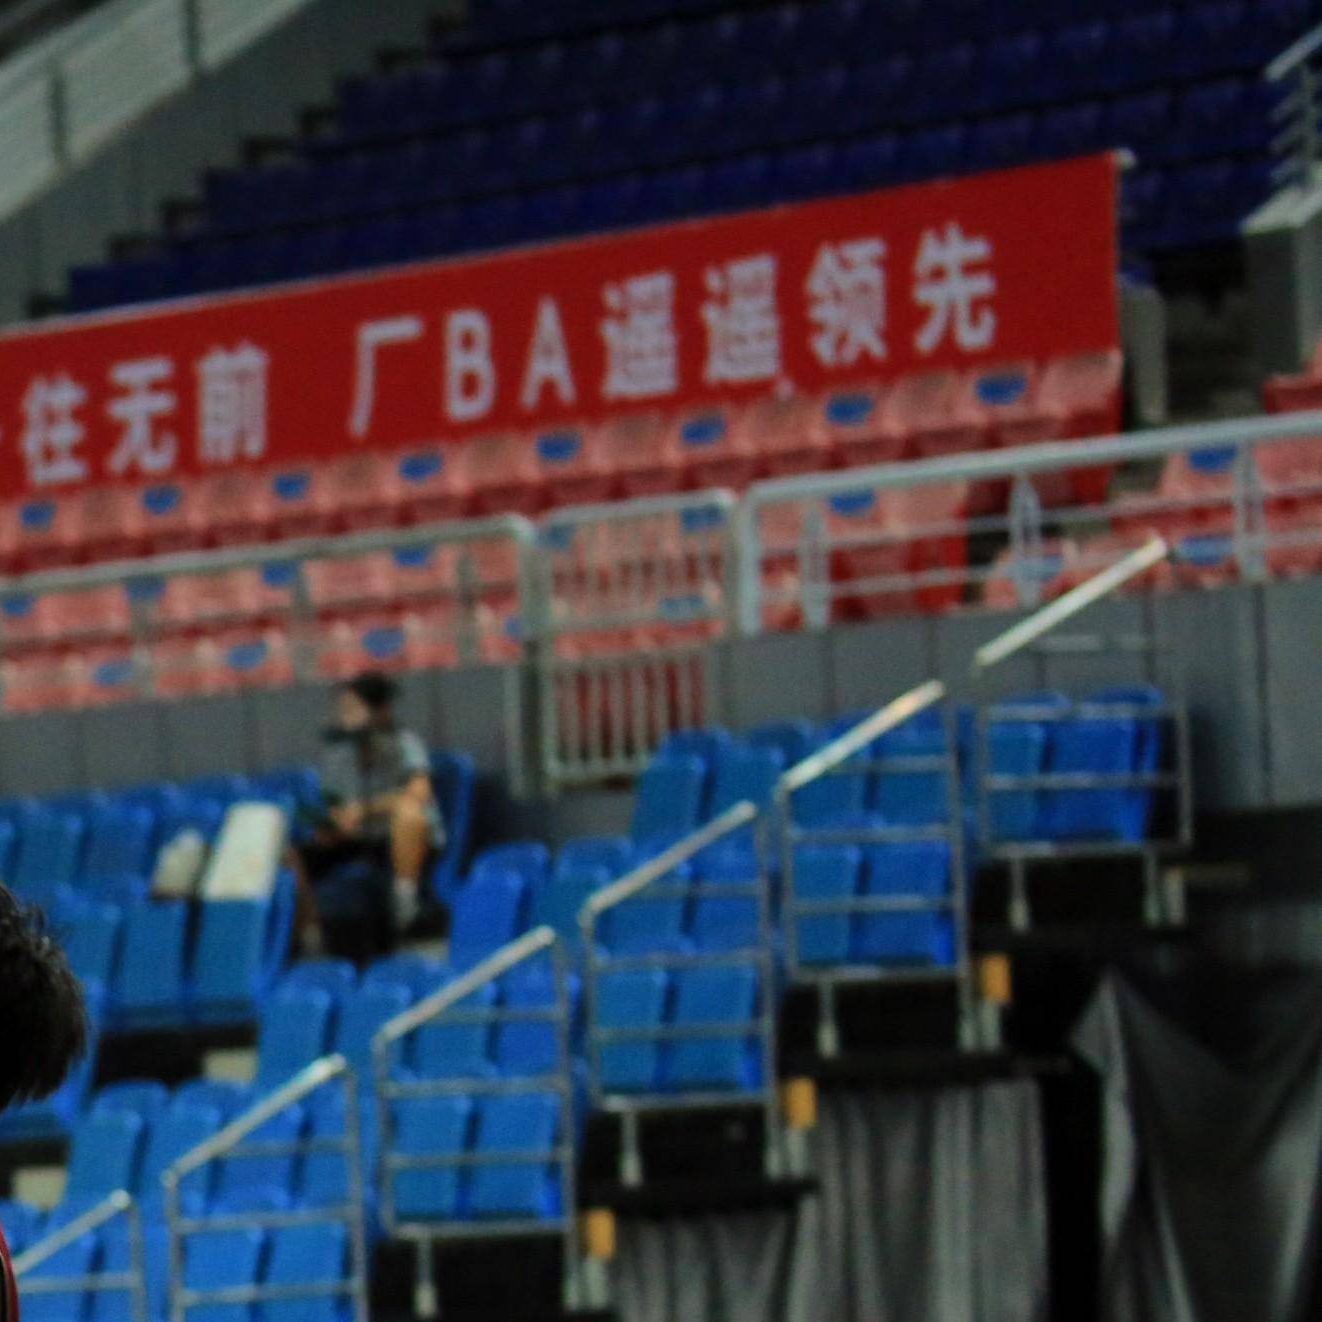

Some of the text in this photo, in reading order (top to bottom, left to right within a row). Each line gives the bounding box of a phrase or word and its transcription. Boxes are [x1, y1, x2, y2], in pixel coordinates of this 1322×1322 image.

[348, 222, 997, 435] 厂BA遥遥领先
